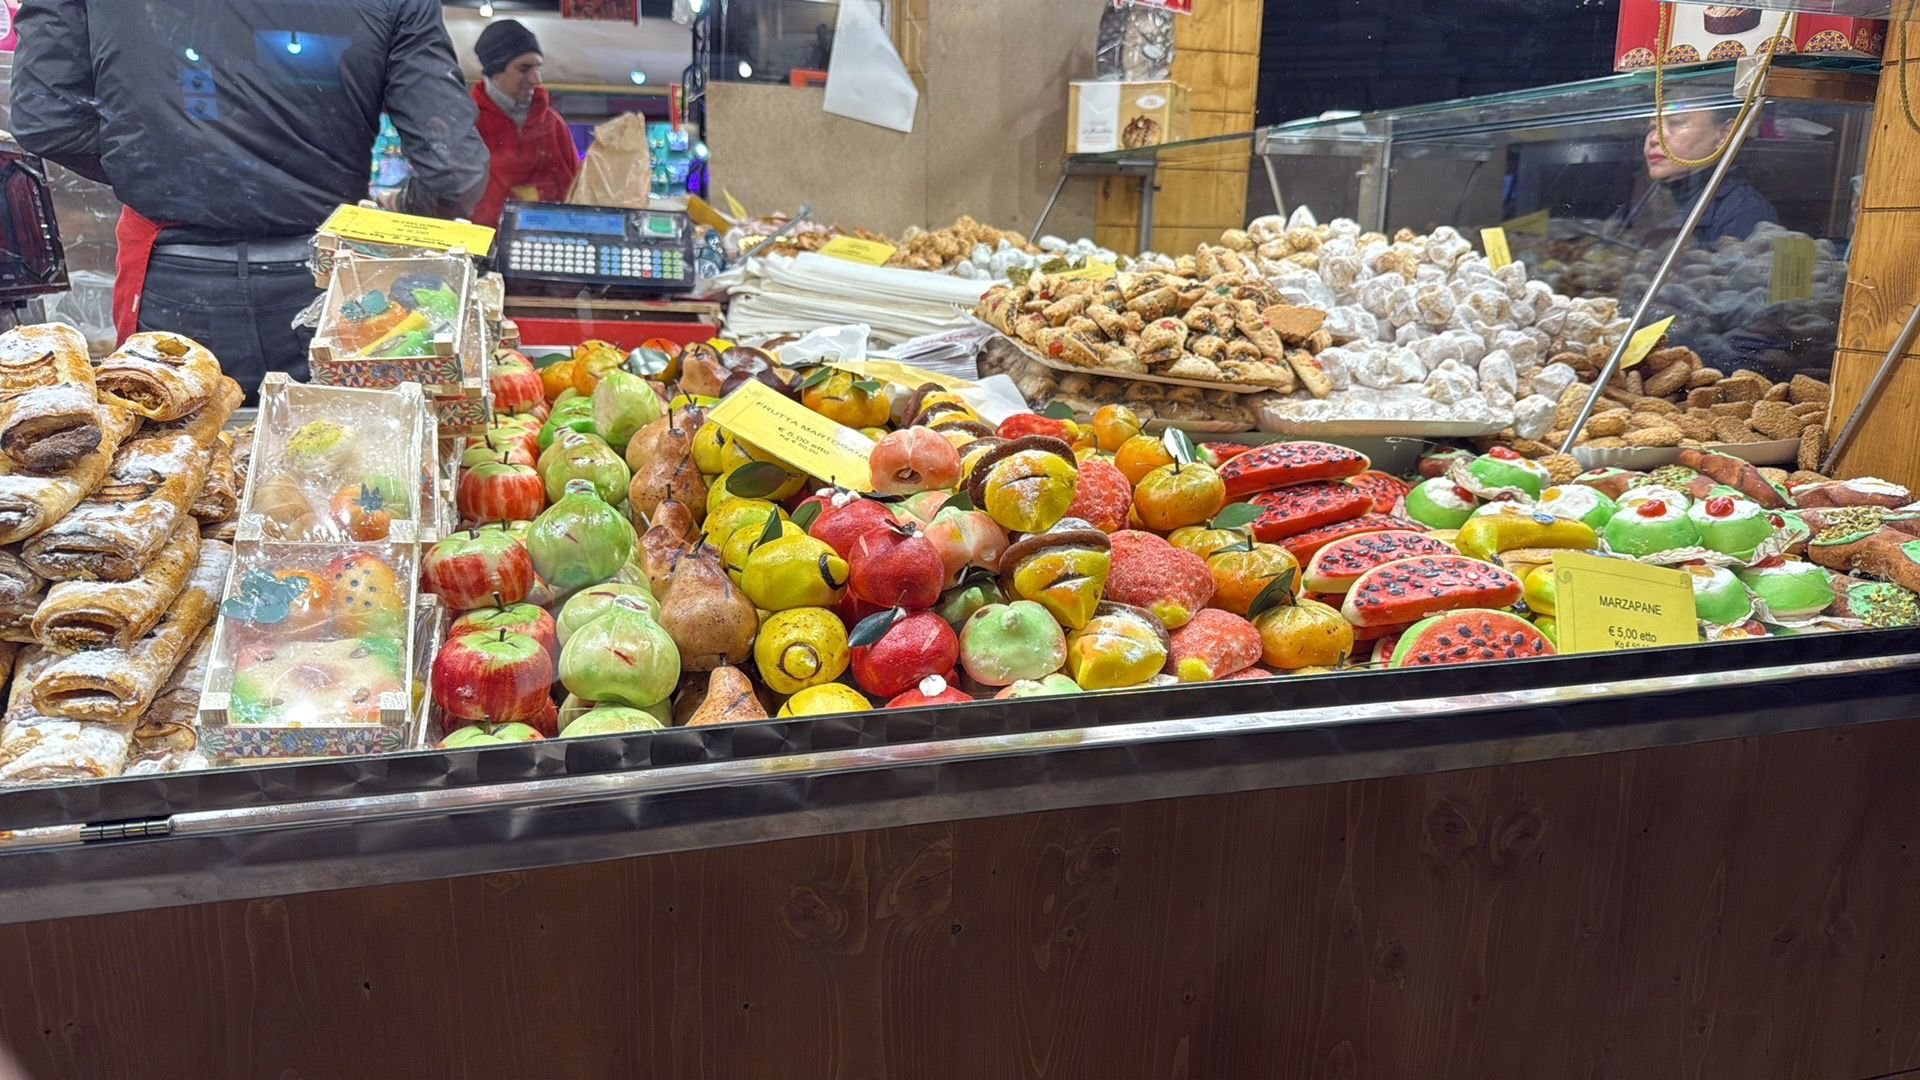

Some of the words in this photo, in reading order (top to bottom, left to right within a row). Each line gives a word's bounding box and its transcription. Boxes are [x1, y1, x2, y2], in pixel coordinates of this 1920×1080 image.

[755, 401, 798, 427] FRUTTA
[786, 431, 810, 445] 5,00
[810, 443, 830, 456] etto
[1599, 595, 1662, 616] MARZAPANE
[1608, 625, 1615, 637] €
[1617, 627, 1638, 640] 5,00
[1639, 632, 1657, 643] etto
